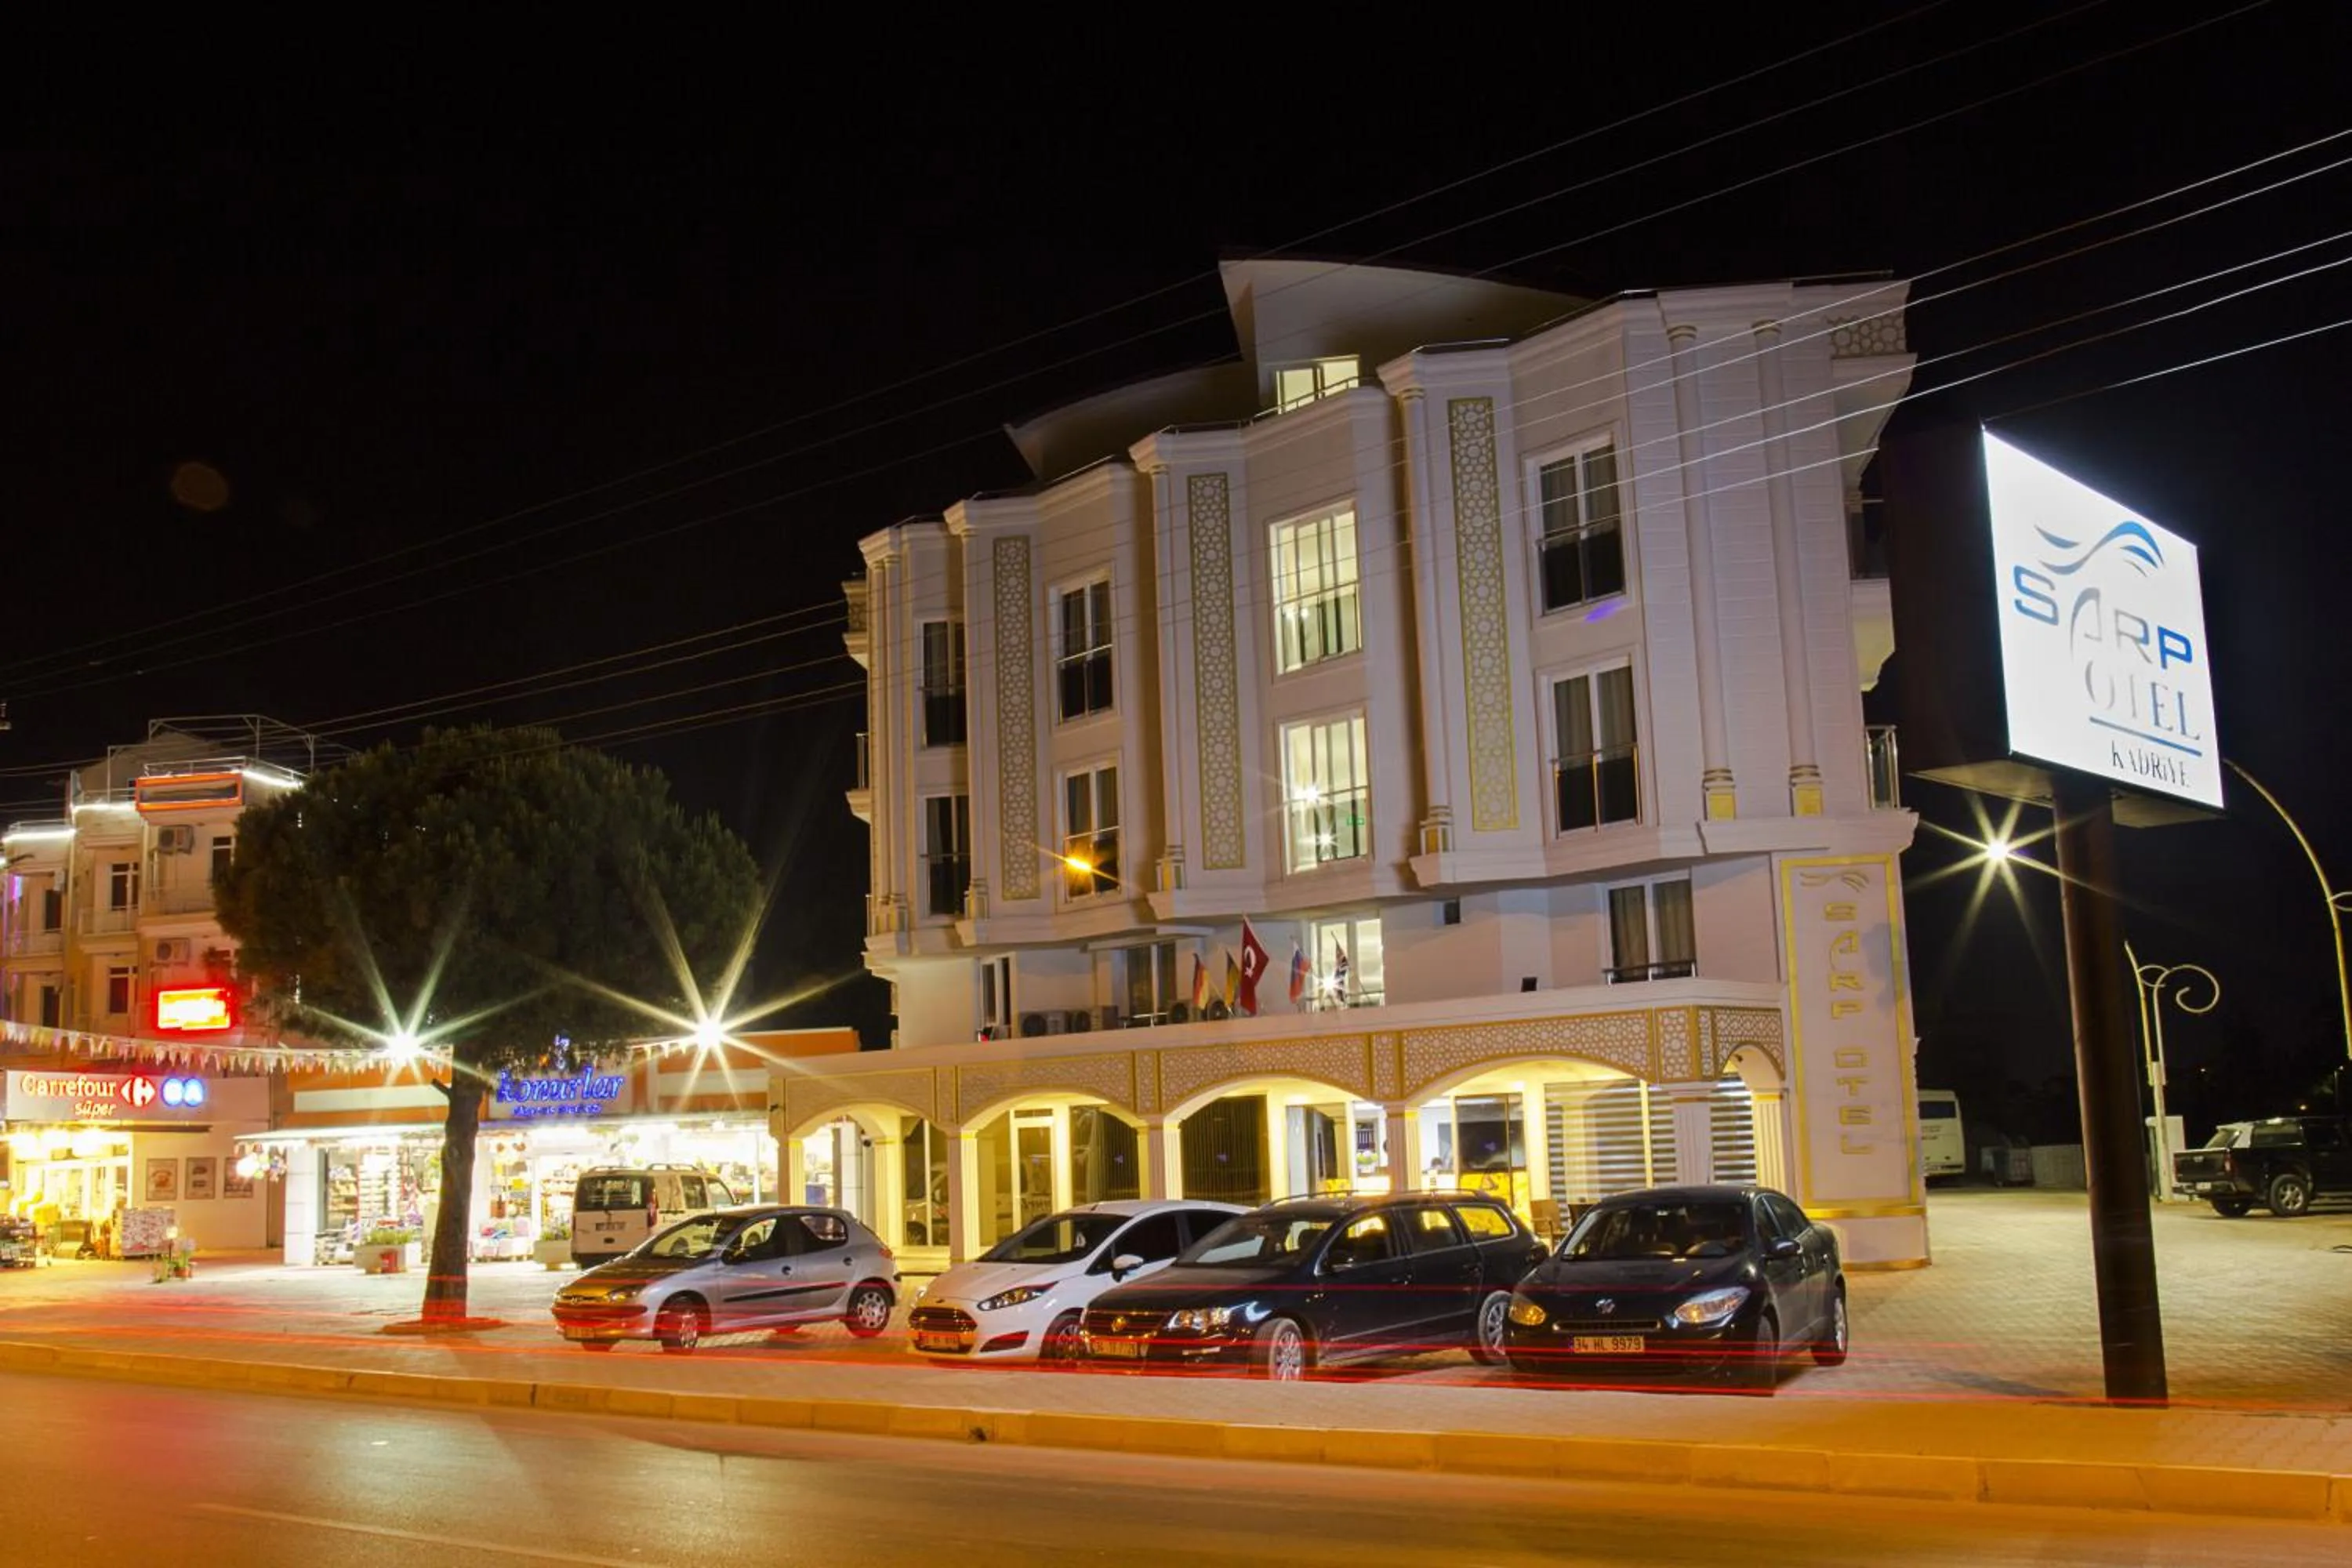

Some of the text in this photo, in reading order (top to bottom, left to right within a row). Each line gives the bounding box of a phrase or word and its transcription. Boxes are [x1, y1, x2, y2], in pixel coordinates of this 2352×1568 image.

[2013, 565, 2193, 670] SARP
[1824, 902, 1875, 1156] SARP OTEL
[21, 1073, 204, 1105] Carrefour A
[74, 1101, 117, 1119] süper
